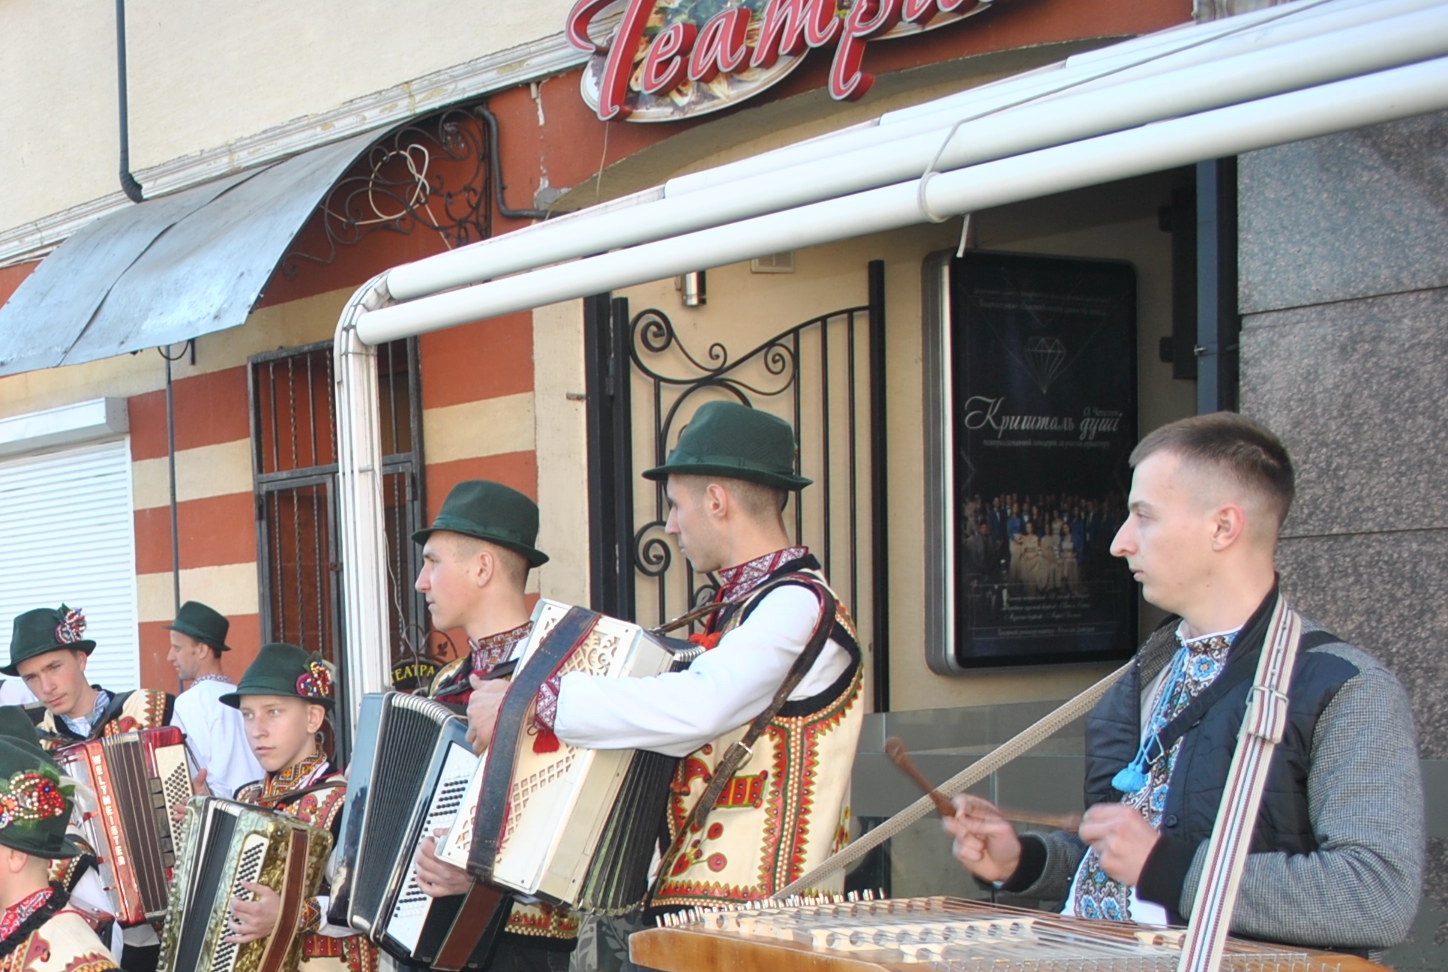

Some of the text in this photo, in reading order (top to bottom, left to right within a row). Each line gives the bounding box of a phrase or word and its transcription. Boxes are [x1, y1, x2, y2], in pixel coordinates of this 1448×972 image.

[964, 395, 1124, 441] Кришталь душі
[91, 754, 126, 866] WELTMEISTER
